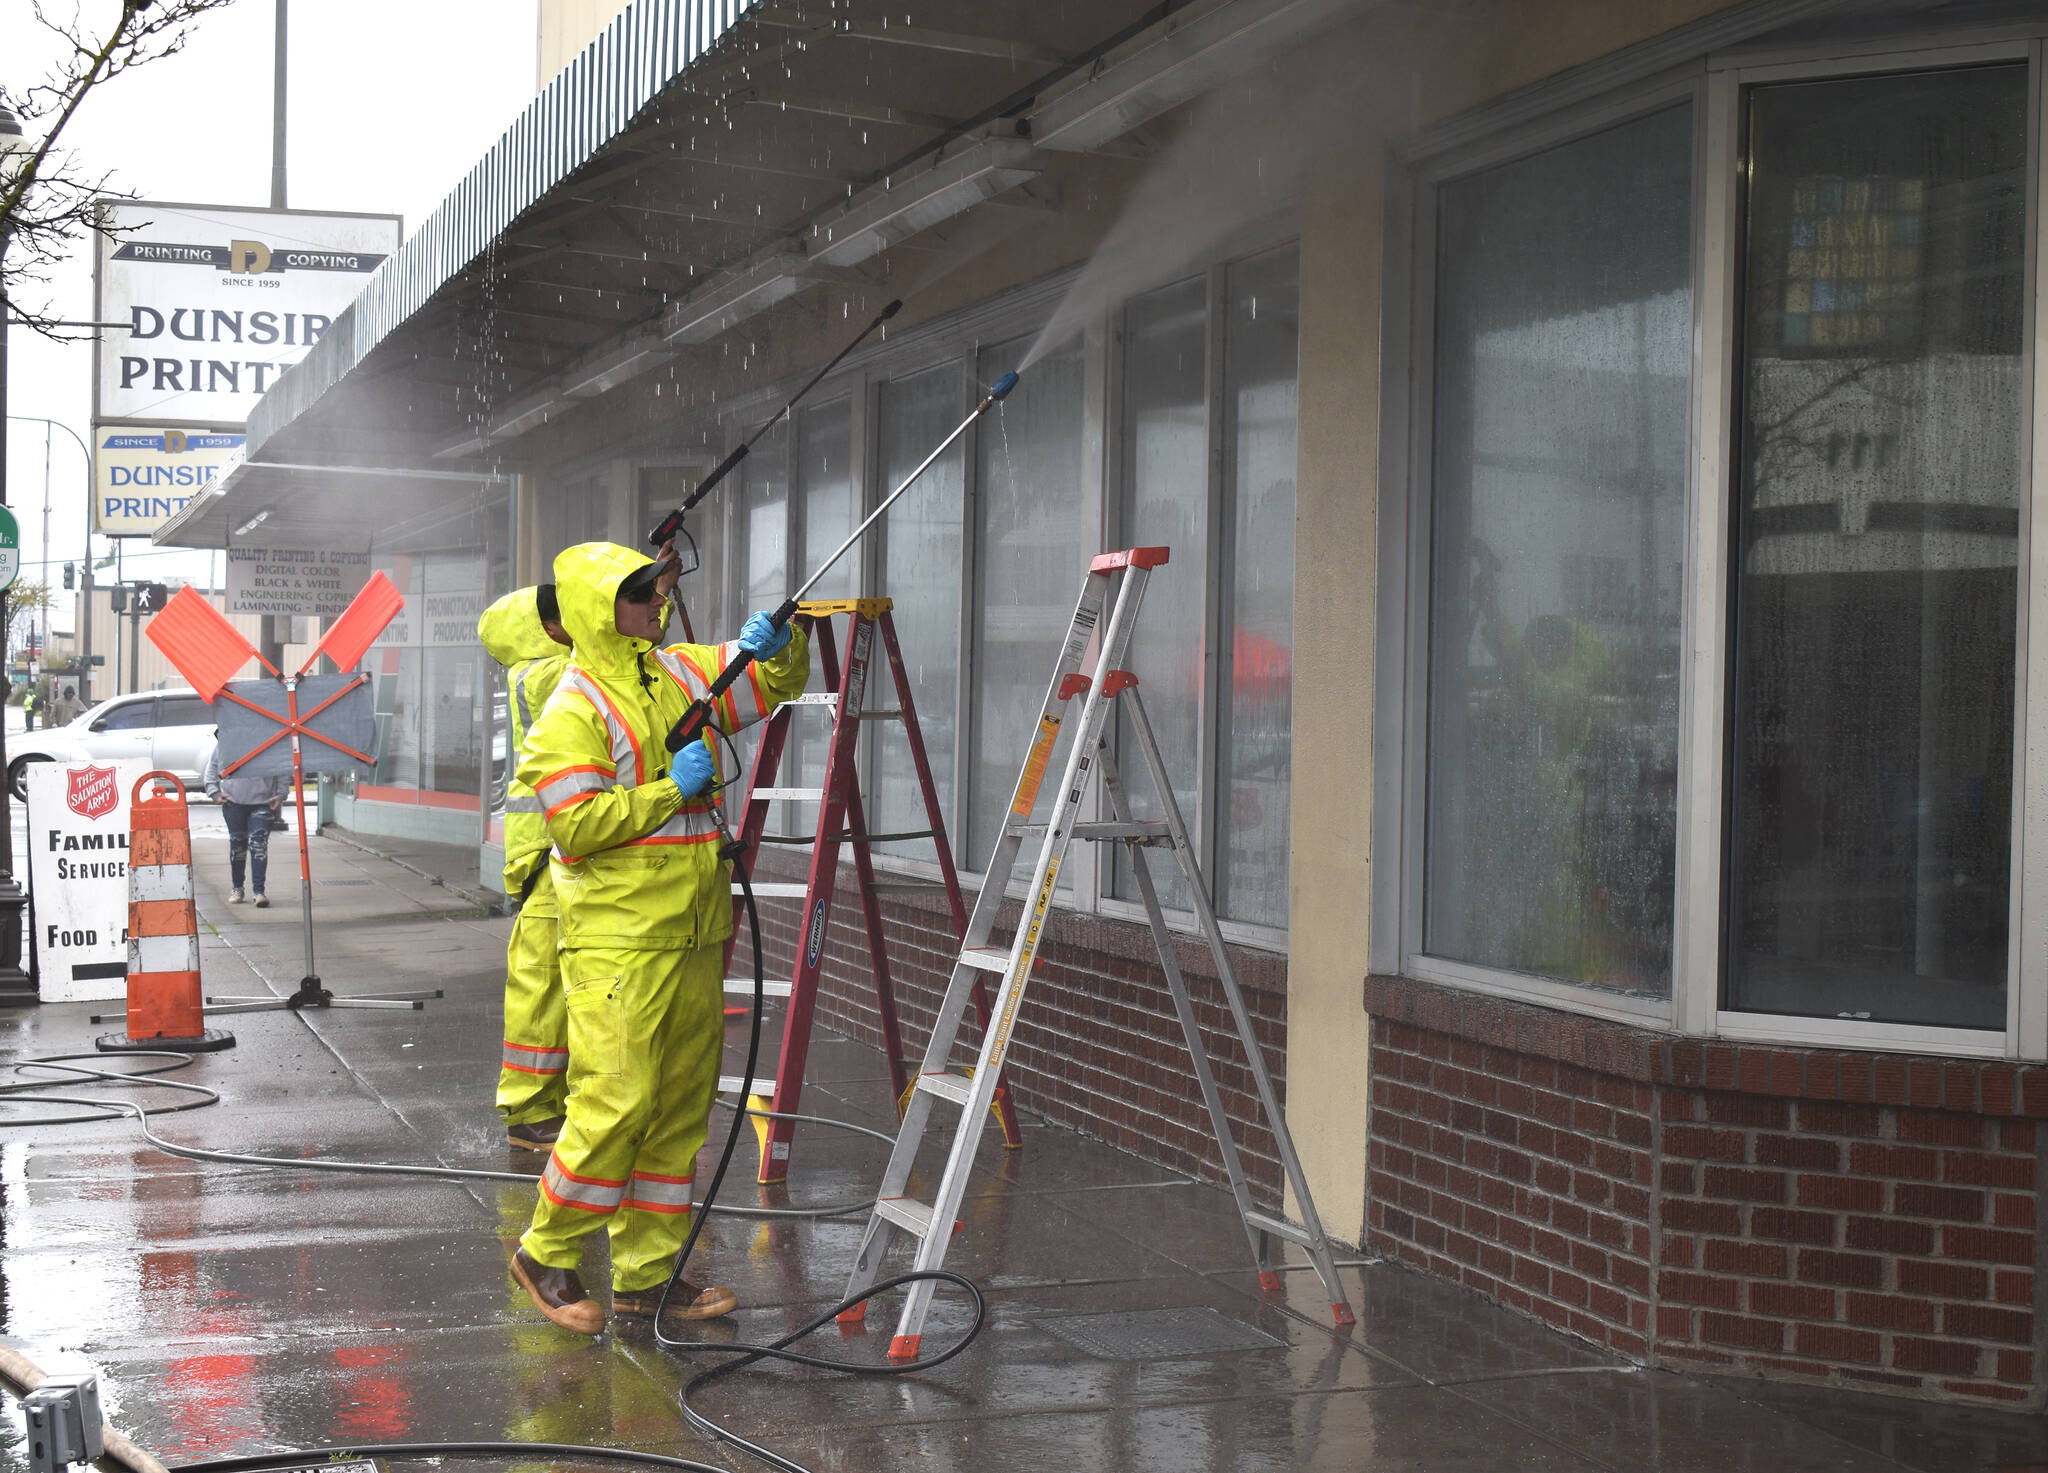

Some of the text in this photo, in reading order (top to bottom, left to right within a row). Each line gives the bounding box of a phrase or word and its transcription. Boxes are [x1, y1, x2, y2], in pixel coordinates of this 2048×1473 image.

[134, 246, 359, 269] PRINTING COPYING
[231, 240, 271, 275] D
[222, 278, 281, 289] SINCE 1959
[114, 438, 232, 447] SINCE 1959
[229, 548, 268, 562] QUALITY
[272, 549, 315, 563] PRINTING
[330, 551, 369, 566] COPYING
[256, 564, 341, 577] DIGITAL COLOR
[255, 577, 342, 589] BLACK & WHITE
[241, 590, 313, 601] ENGINEERING
[233, 601, 302, 613] LAMINATING
[77, 771, 96, 789] THE
[71, 772, 113, 807] SALVATION
[86, 787, 112, 813] ARMY
[58, 858, 130, 880] SERVICE
[811, 911, 823, 954] WERNER
